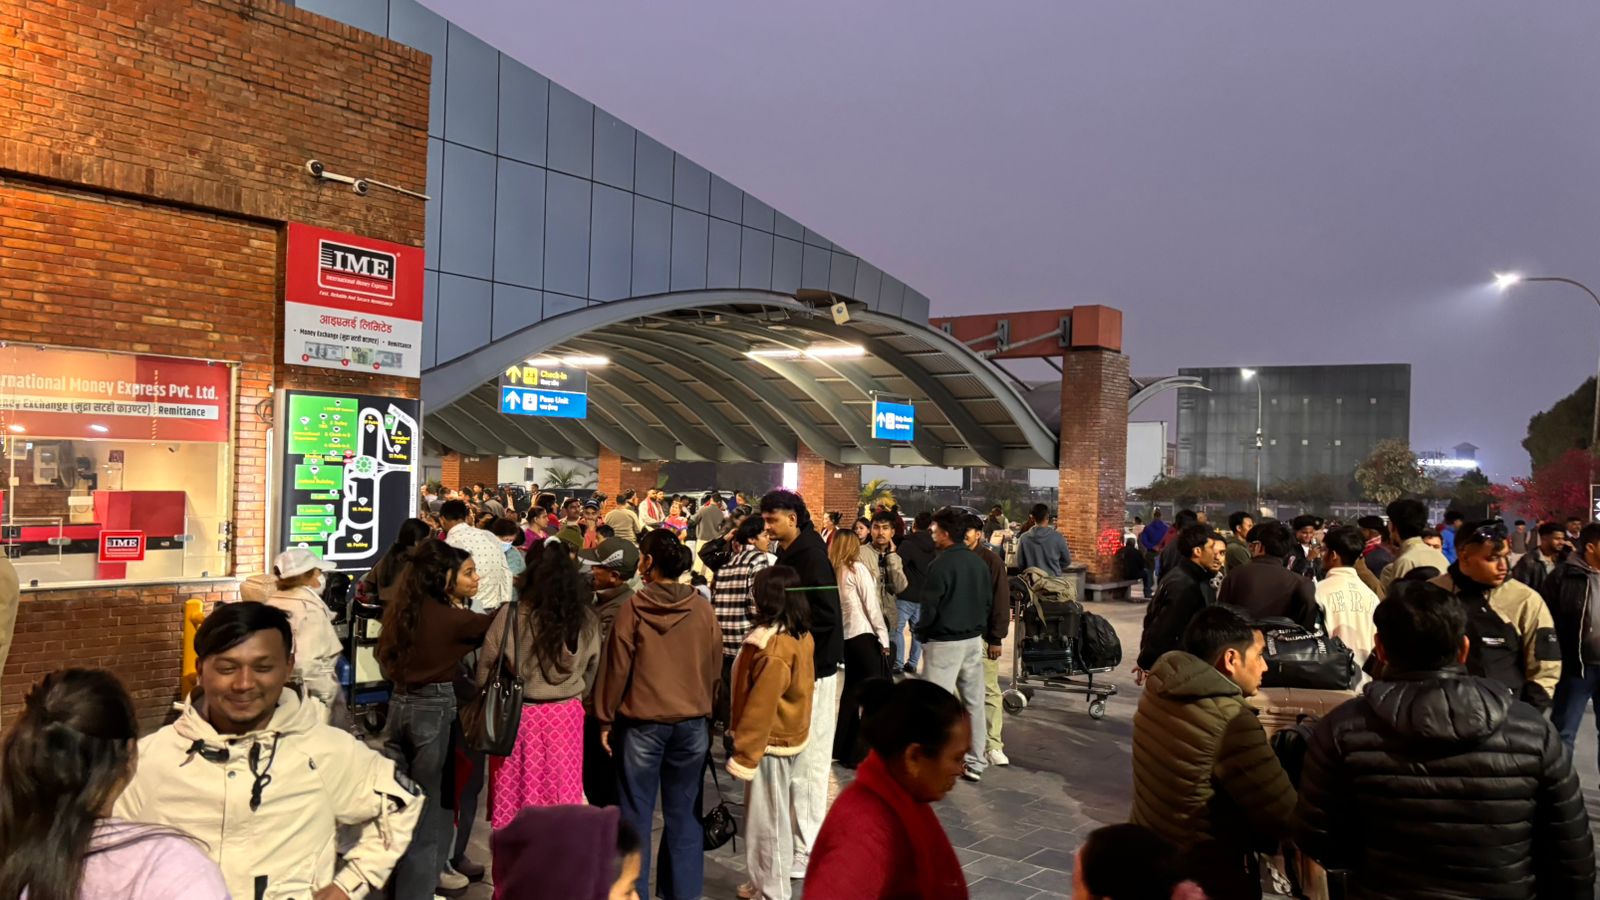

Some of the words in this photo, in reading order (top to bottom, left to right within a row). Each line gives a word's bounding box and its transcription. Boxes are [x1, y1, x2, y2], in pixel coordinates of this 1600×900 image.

[333, 250, 389, 279] IME
[360, 318, 393, 333] लिमिटेड
[299, 328, 316, 337] Money
[317, 330, 339, 339] Exchange
[387, 340, 412, 349] Remittance
[69, 376, 114, 397] Money
[117, 381, 166, 398] Express
[169, 384, 193, 398] Pvt.
[196, 385, 219, 400] Ltd.
[158, 406, 206, 417] Remittance
[112, 539, 137, 547] IME
